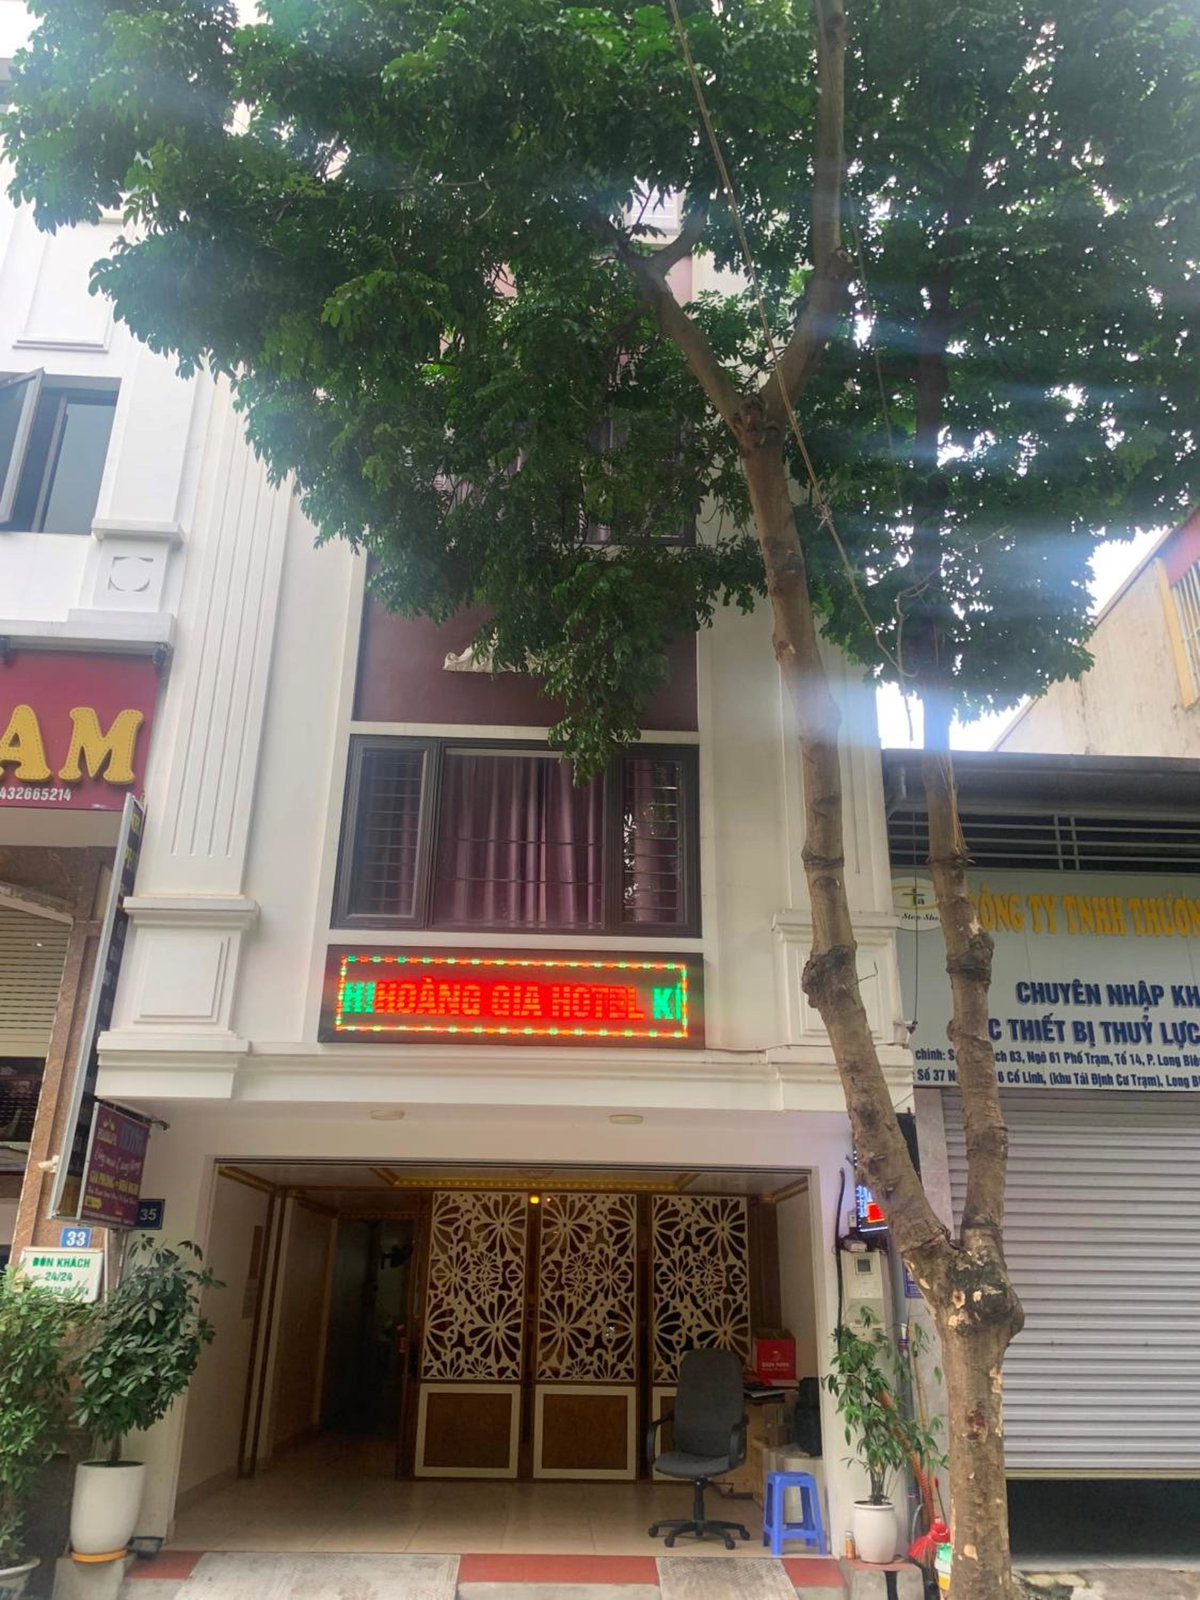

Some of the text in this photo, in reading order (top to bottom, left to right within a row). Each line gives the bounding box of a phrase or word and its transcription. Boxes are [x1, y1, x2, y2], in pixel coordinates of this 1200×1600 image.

[969, 883, 1025, 933] ÔNG
[1028, 894, 1057, 934] TY
[1063, 894, 1126, 935] TNHH
[490, 984, 543, 1017] GIA
[552, 984, 646, 1020] HOTEL
[1016, 979, 1101, 1004] CHUYÊN
[1106, 981, 1164, 1010] NHẬP
[1007, 1013, 1066, 1043] THIẾT
[1072, 1020, 1096, 1048] BỊ
[140, 1208, 157, 1221] 35
[66, 1231, 86, 1246] 33
